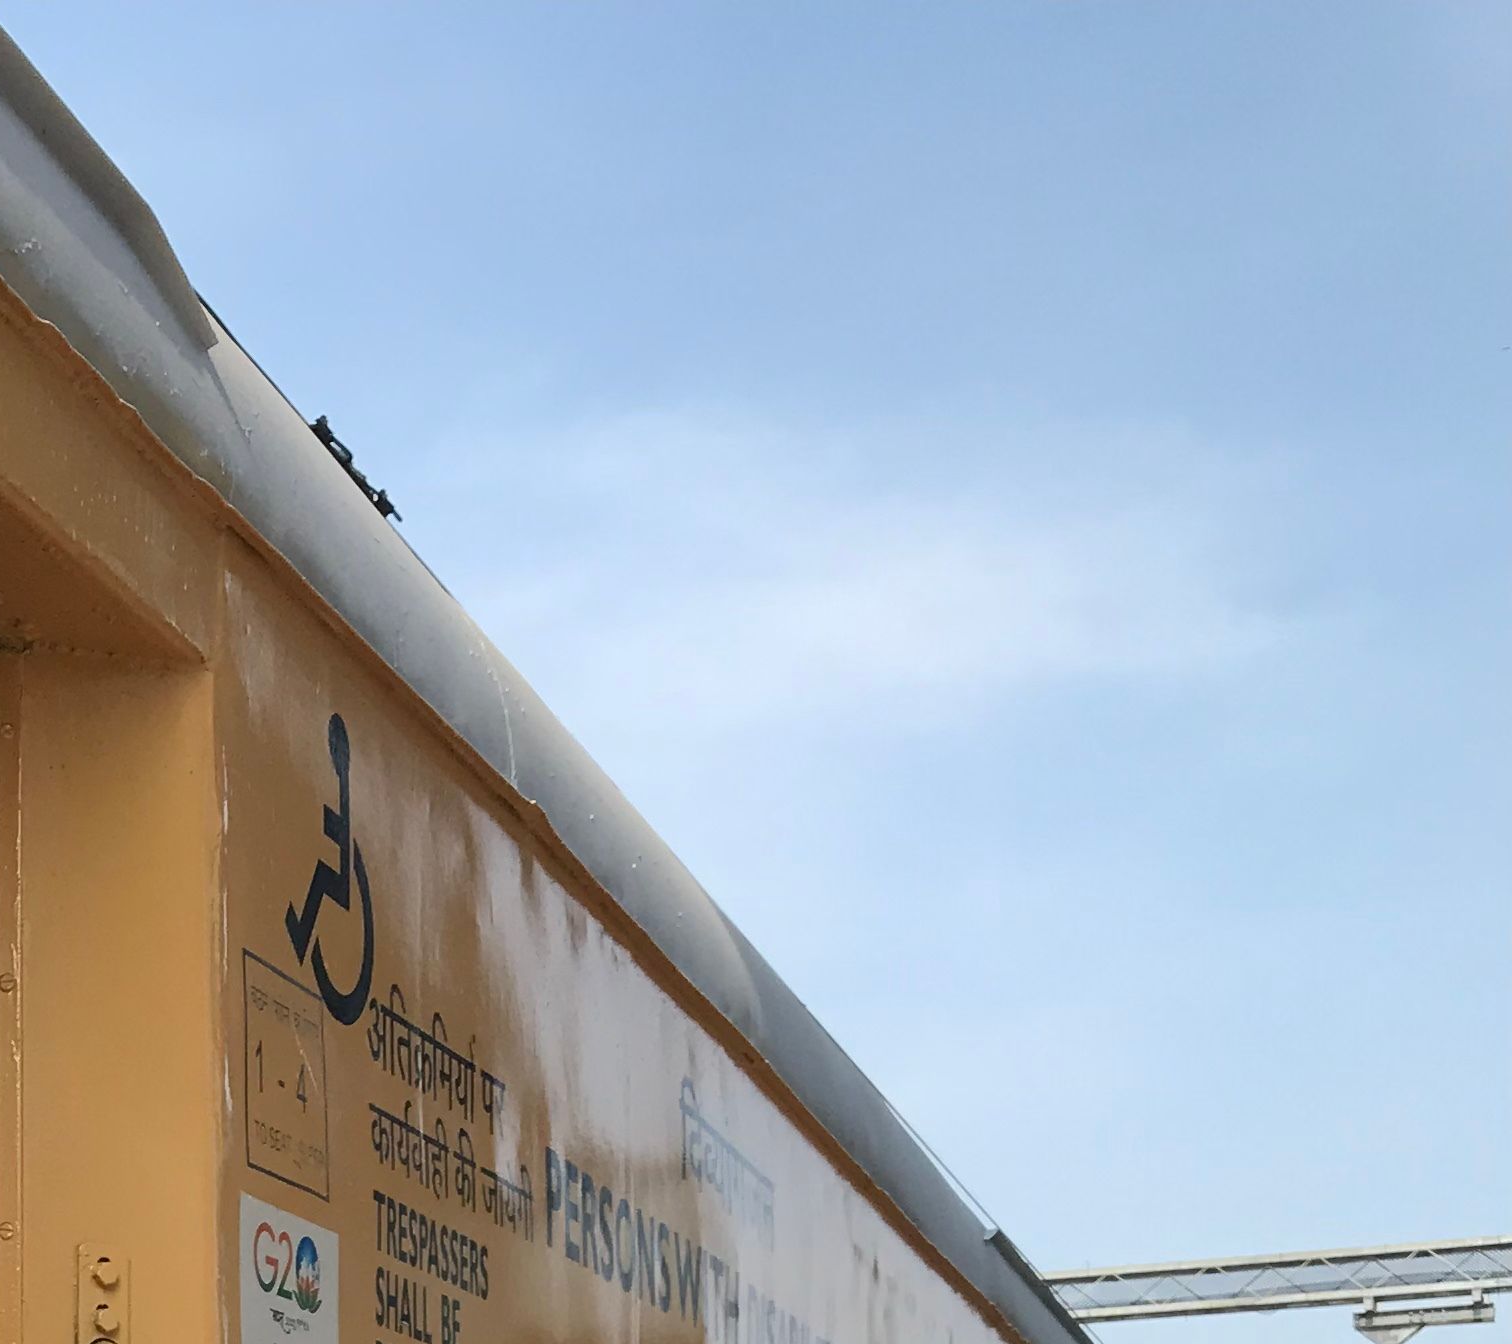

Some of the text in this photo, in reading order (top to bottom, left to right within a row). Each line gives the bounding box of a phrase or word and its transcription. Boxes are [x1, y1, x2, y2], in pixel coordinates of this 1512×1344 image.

[254, 1039, 264, 1093] 1
[296, 1062, 309, 1114] 4
[453, 1127, 477, 1213] की
[253, 1221, 322, 1315] G20
[373, 1189, 489, 1301] TRESPASSERS
[545, 1144, 672, 1314] PERSONS
[375, 1265, 433, 1344] SHALL
